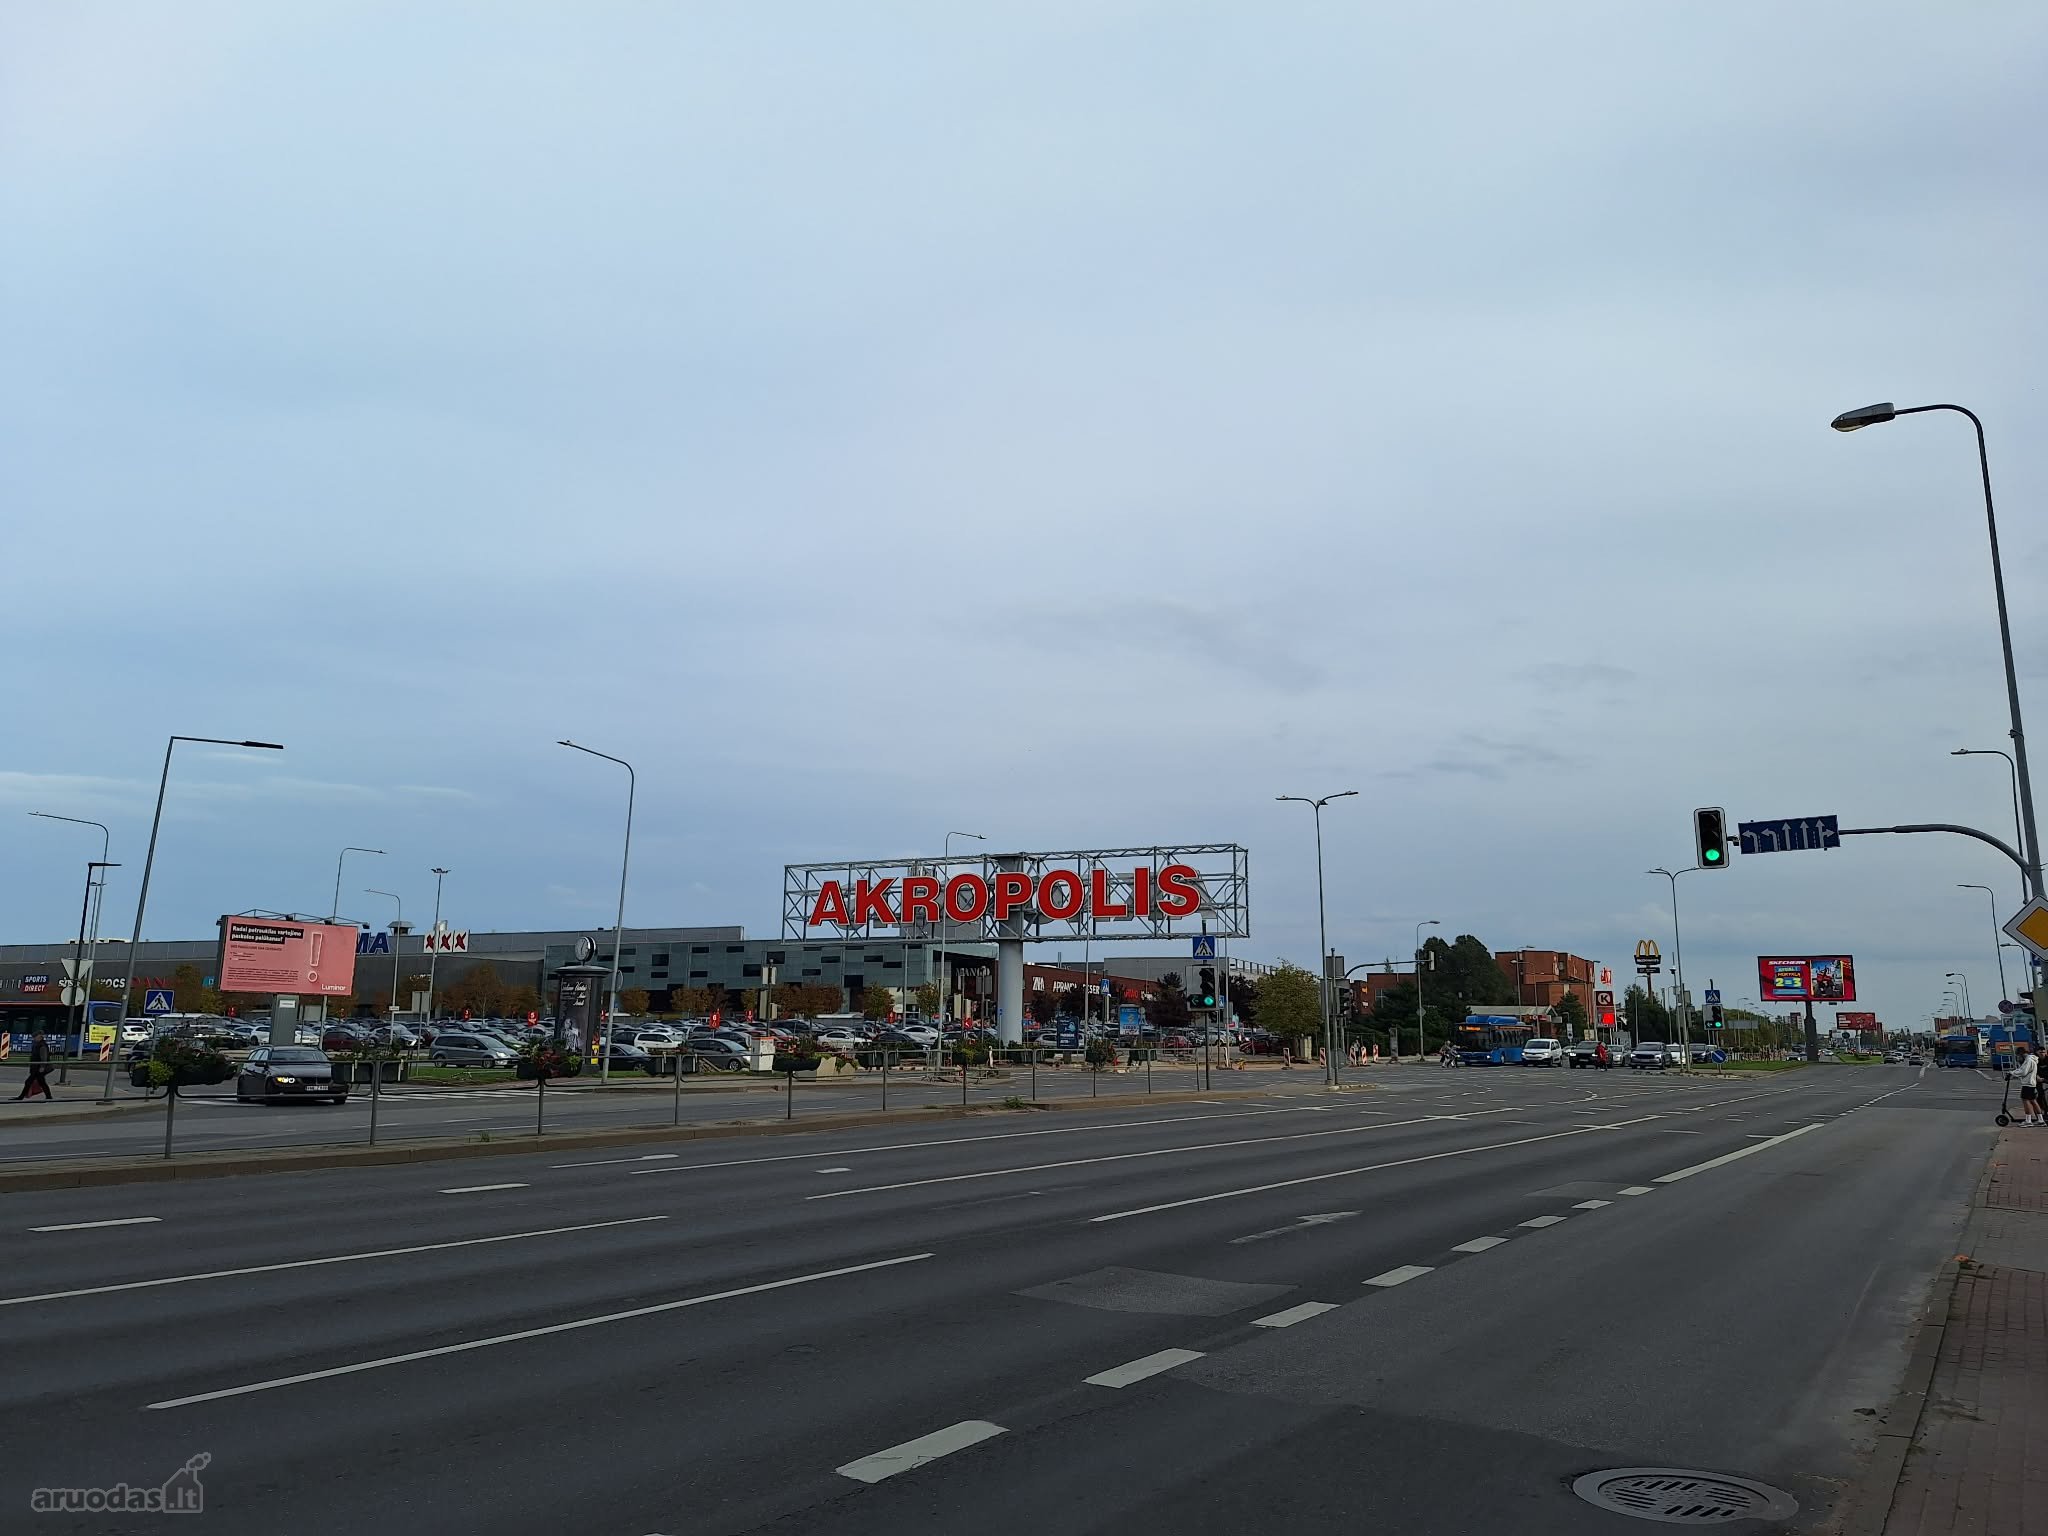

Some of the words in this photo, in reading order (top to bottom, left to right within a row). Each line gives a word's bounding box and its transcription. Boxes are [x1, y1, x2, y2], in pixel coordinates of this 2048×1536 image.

[809, 864, 1201, 927] AKROPOLIS
[955, 966, 991, 977] MANGO
[24, 975, 48, 983] SPORTS
[24, 984, 46, 992] DIRECT
[321, 983, 346, 991] Luminor
